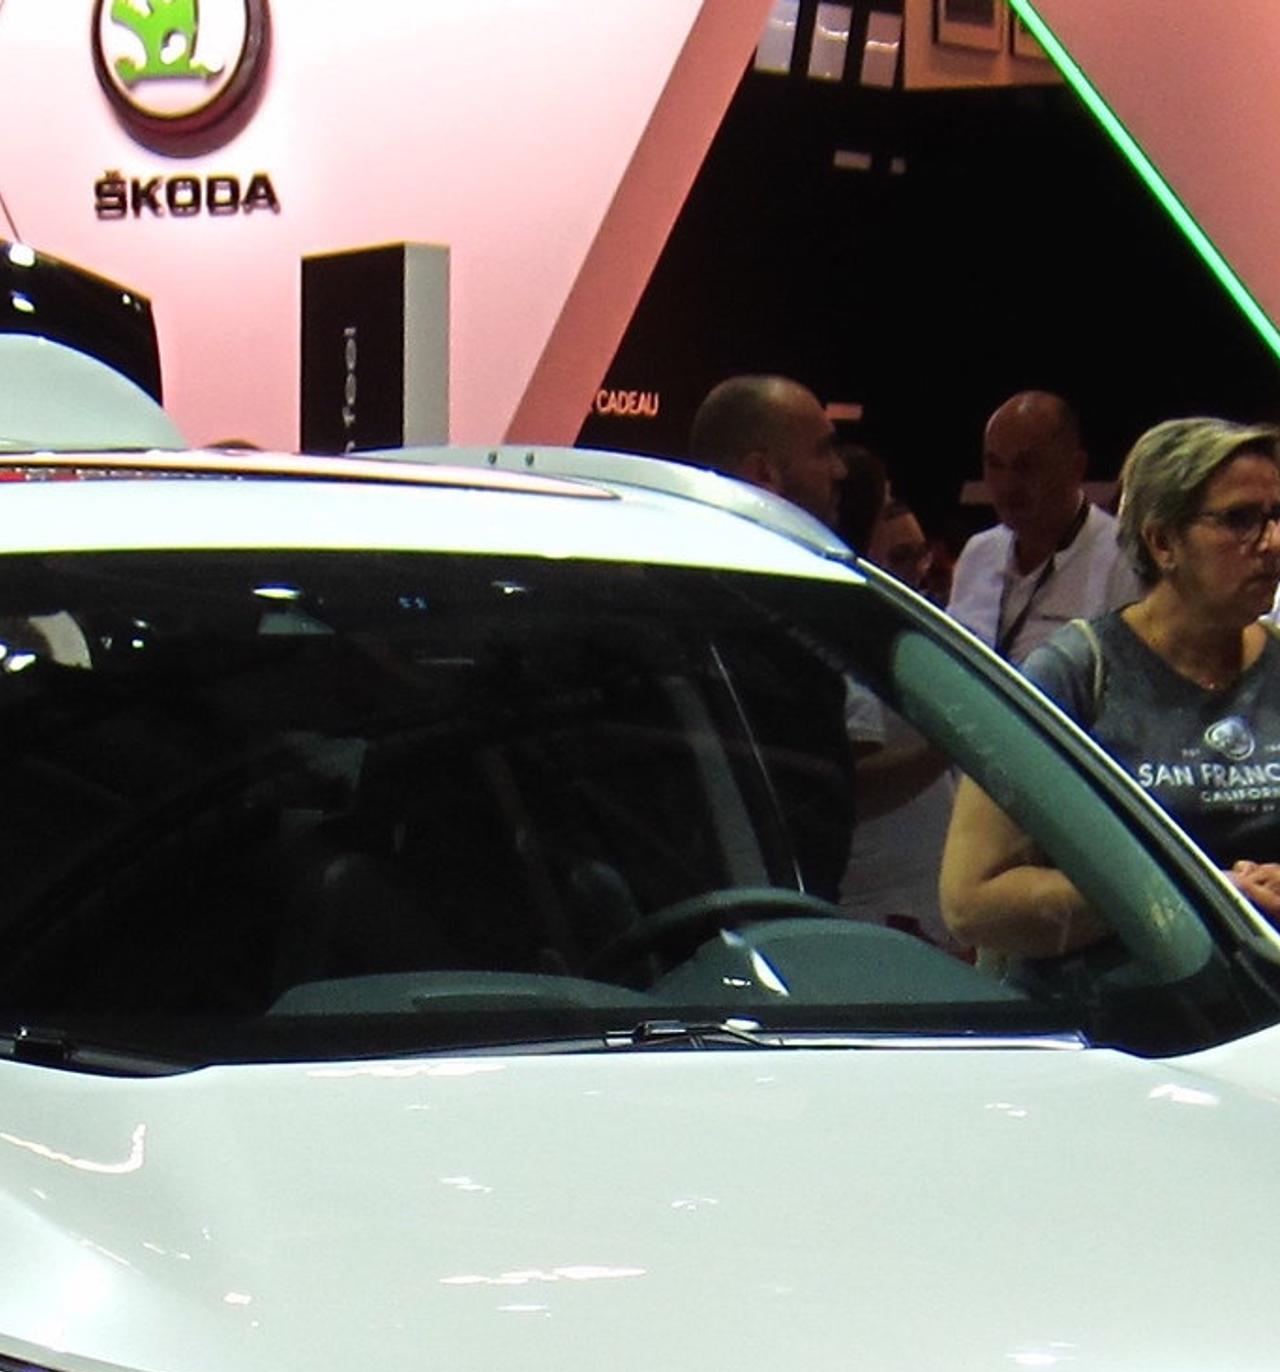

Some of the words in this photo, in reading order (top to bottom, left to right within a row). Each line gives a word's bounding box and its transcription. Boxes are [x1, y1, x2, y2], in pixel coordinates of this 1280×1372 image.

[95, 170, 281, 220] ŠKODA
[597, 390, 658, 416] CADEAU
[1138, 762, 1195, 787] SAN
